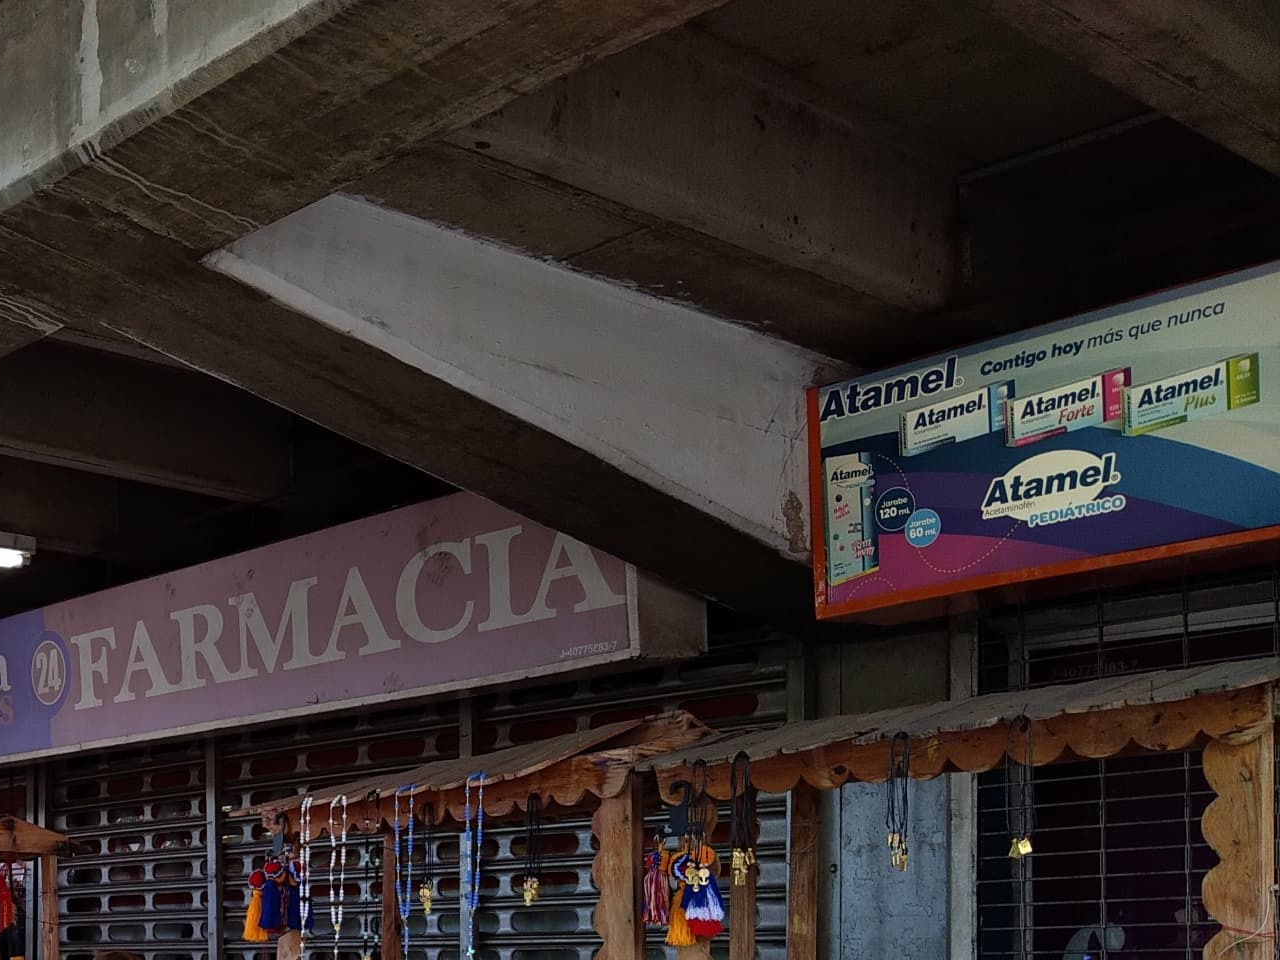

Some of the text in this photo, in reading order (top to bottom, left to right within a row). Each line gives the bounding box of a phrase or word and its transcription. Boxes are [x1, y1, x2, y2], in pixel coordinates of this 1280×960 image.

[980, 301, 1226, 377] Contigo hoy más que nunca
[821, 357, 958, 422] Atamel
[1020, 380, 1098, 420] Atamel
[1137, 367, 1222, 409] Atamel
[1183, 393, 1217, 413] Plus
[914, 393, 984, 430] Atamel
[1058, 403, 1095, 425] Forte
[831, 465, 871, 482] Atamel
[985, 456, 1116, 508] Atamel
[879, 507, 898, 520] 120
[881, 497, 908, 508] Jarabe
[984, 500, 1035, 517] Acetaminofén
[1029, 496, 1125, 526] PEDIÁTRICO
[909, 517, 936, 528] Jarabe
[909, 527, 924, 539] 60
[70, 525, 626, 711] FARMACIA
[35, 647, 62, 694] 24
